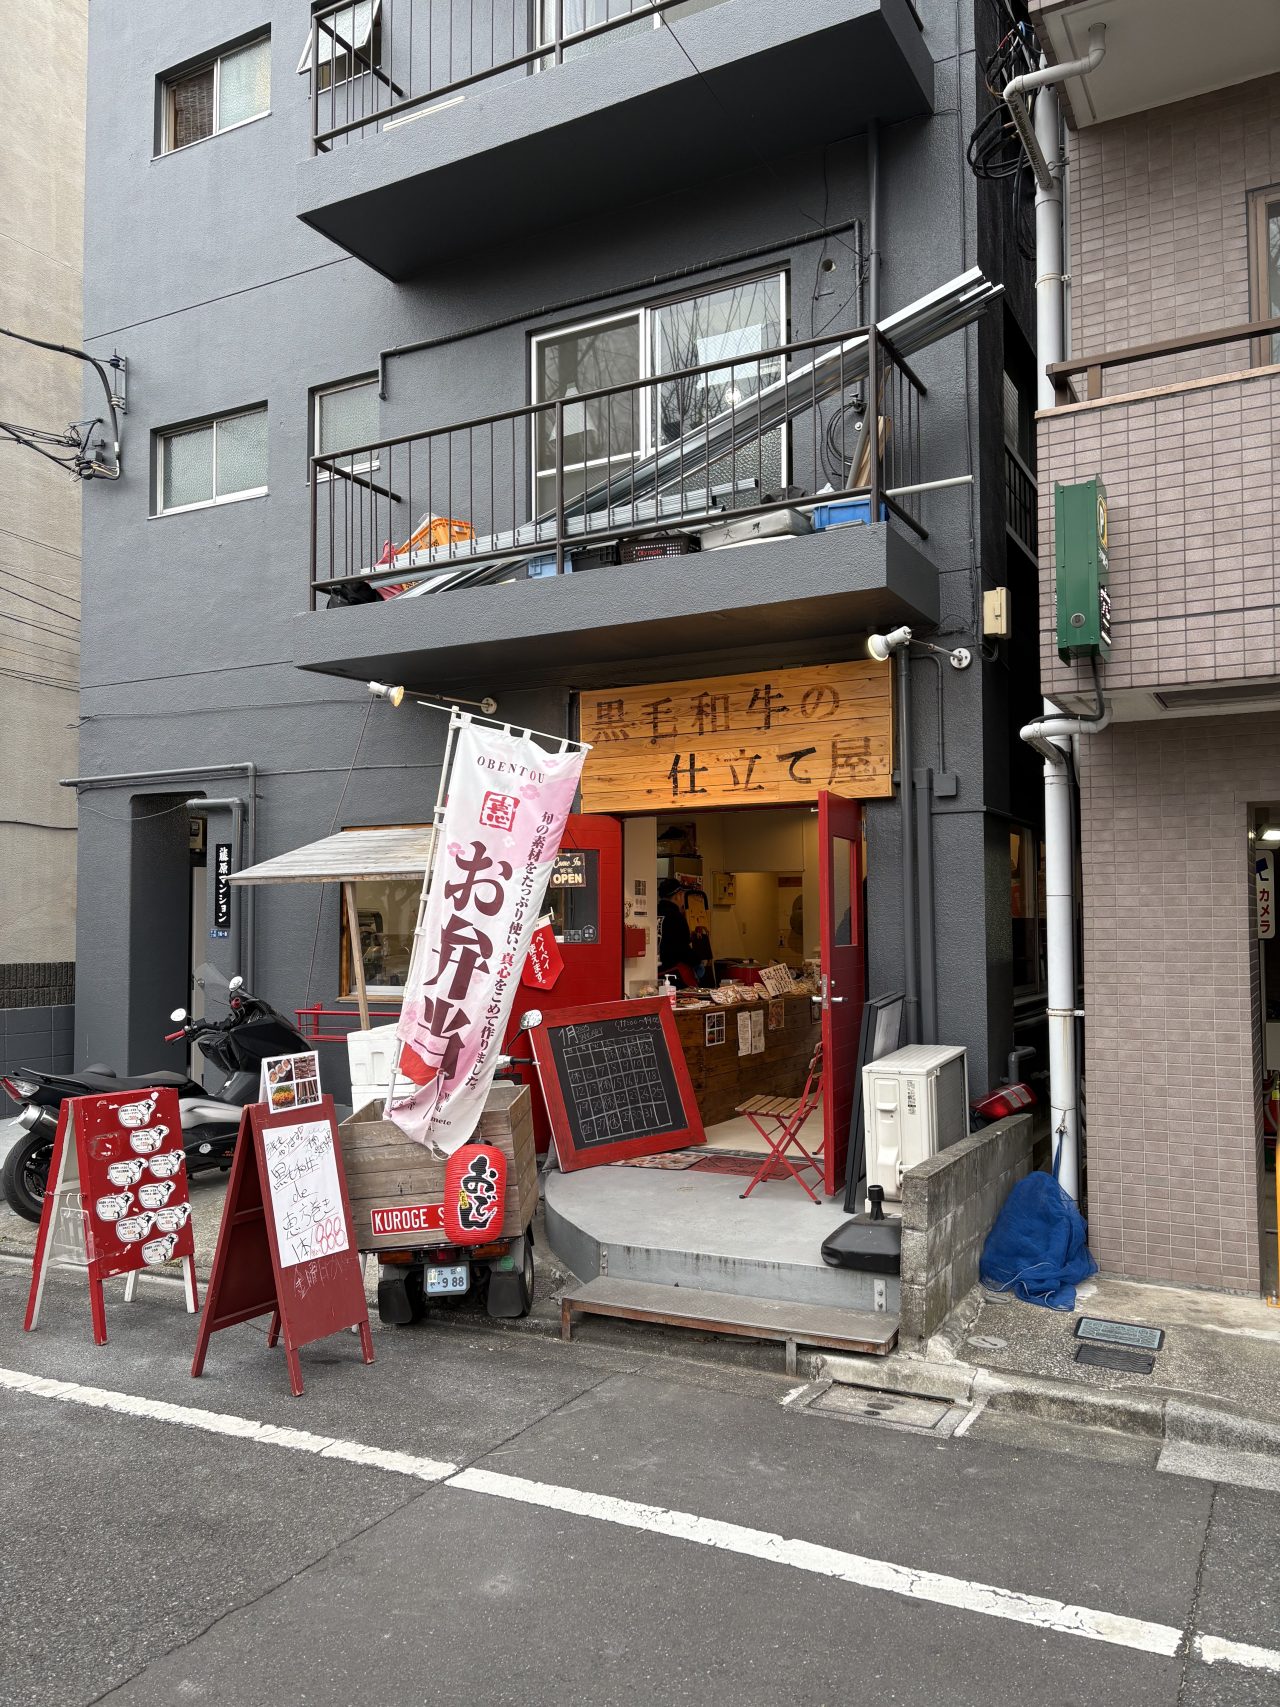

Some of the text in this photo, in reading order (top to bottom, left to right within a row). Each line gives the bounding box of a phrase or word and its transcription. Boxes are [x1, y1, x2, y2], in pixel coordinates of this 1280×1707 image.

[592, 684, 840, 741] 黒毛和牛の
[477, 756, 546, 784] OBENTOU
[668, 733, 878, 796] 仕立て屋
[553, 873, 582, 884] OPEN
[1259, 888, 1271, 933] カメラ
[418, 840, 514, 1080] お弁当
[374, 1208, 429, 1232] KUROGE
